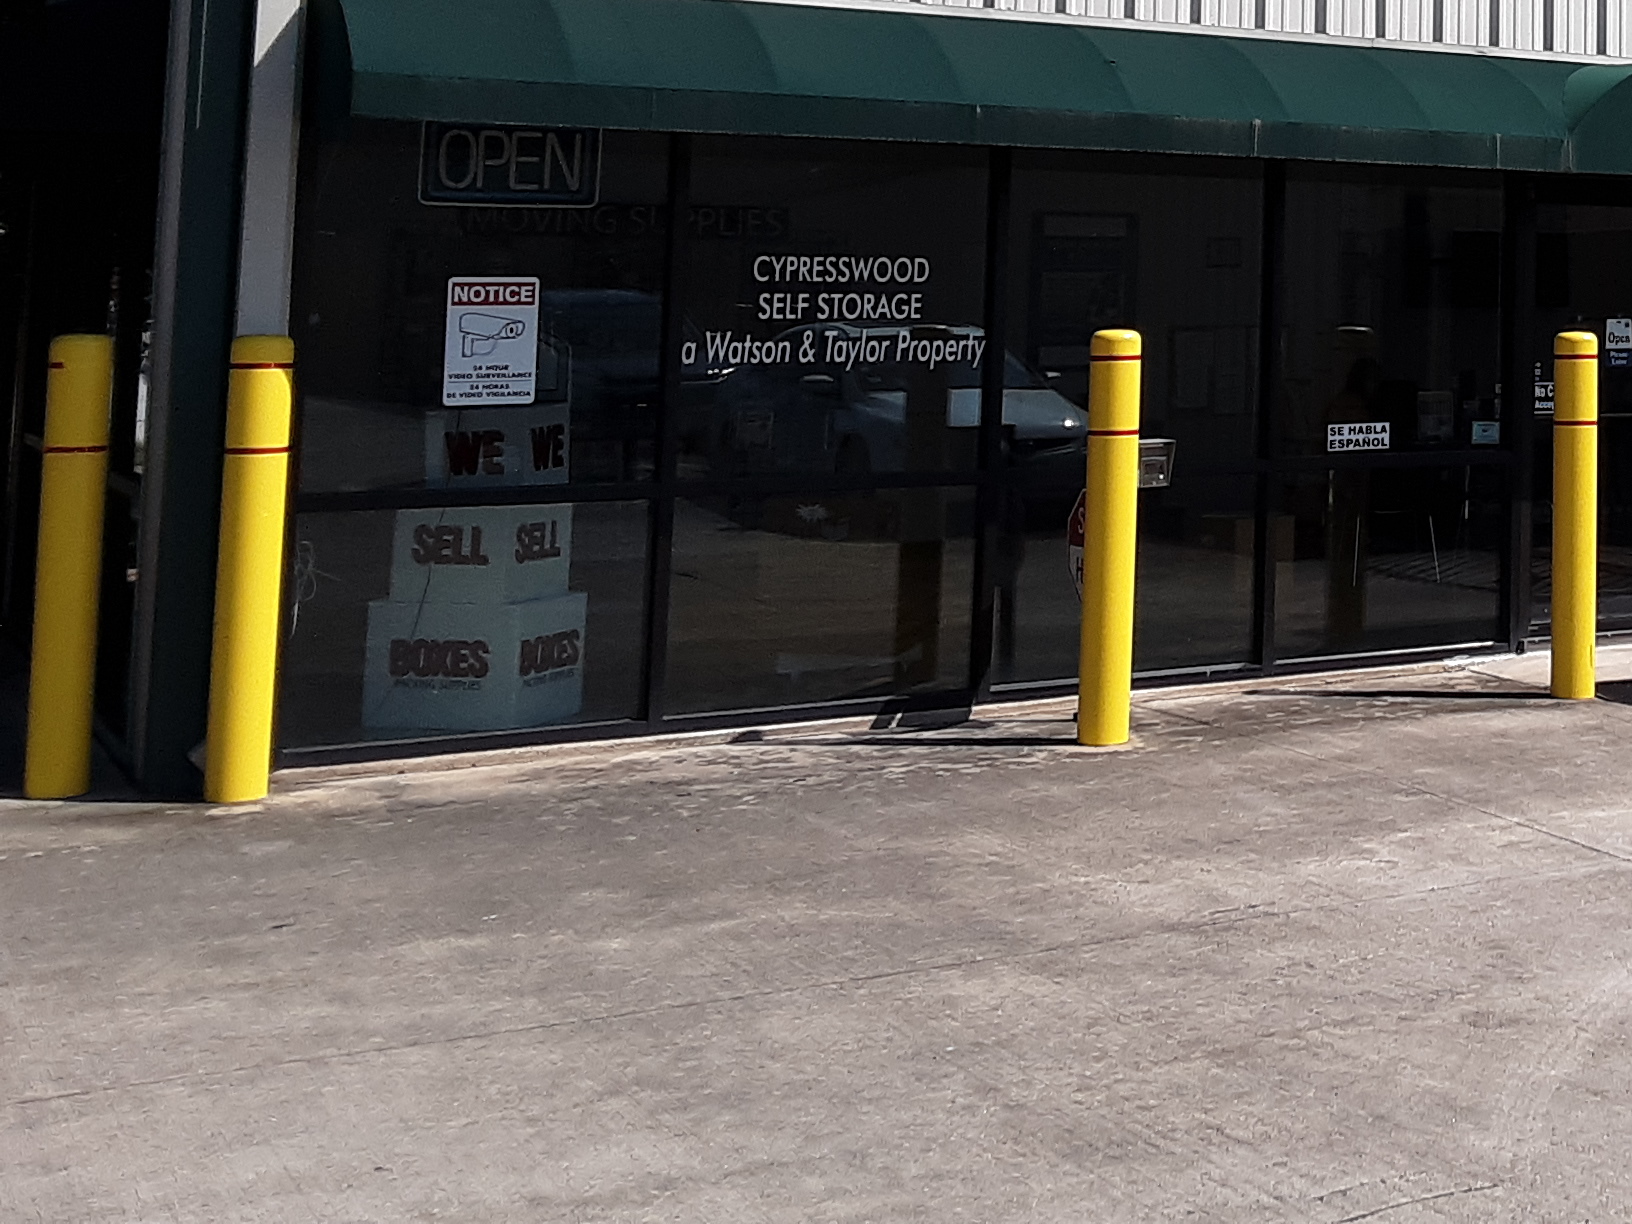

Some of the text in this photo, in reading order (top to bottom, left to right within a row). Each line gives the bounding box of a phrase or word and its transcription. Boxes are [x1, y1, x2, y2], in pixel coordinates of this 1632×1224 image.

[438, 129, 582, 191] OPEN
[467, 206, 617, 235] MOVING
[753, 255, 930, 282] CYPRESSWOOD
[453, 285, 534, 303] NOTICE
[757, 293, 923, 319] SELF STORAGE
[681, 330, 986, 372] a Watson & Taylor Property
[1608, 332, 1630, 345] Open
[530, 424, 565, 471] WE
[1329, 424, 1388, 436] SE HABLA
[1329, 437, 1388, 449] ESPAÑOL
[444, 429, 506, 476] WE
[411, 524, 490, 566] SELL
[515, 520, 561, 564] SELL
[388, 638, 490, 678] BOXES
[519, 628, 580, 676] BOXES
